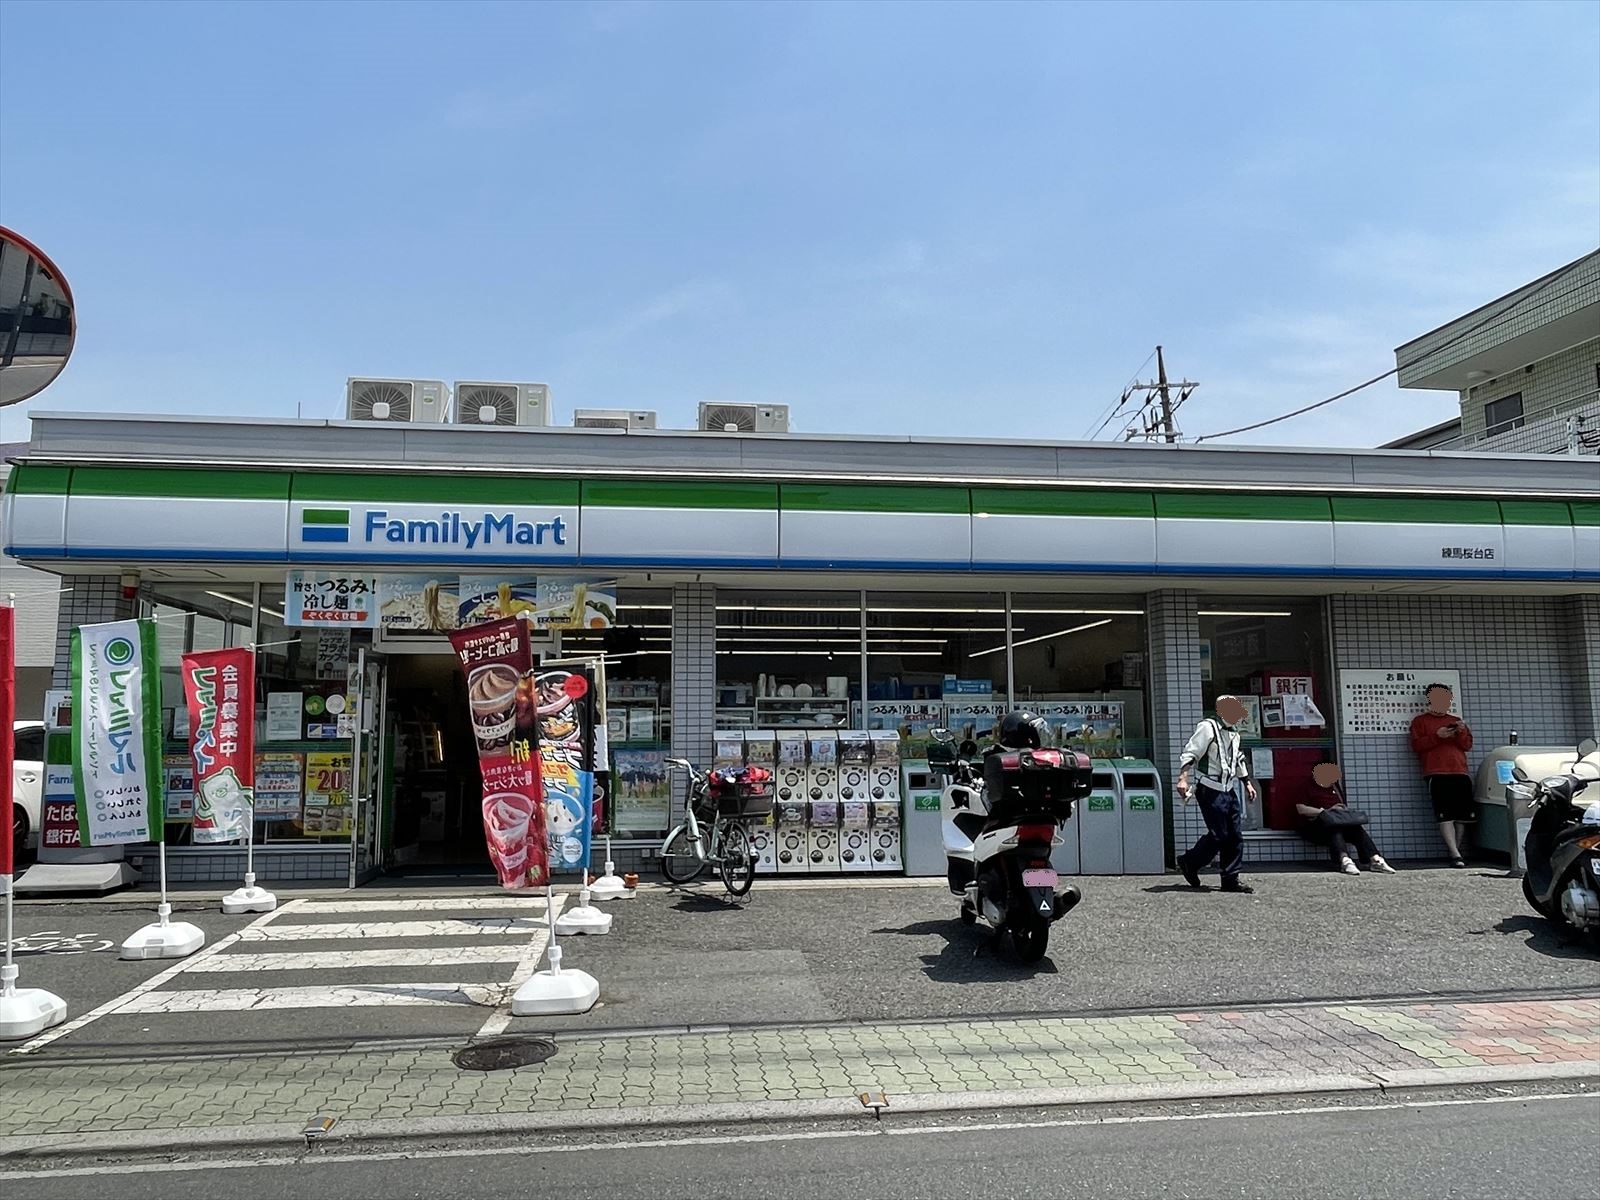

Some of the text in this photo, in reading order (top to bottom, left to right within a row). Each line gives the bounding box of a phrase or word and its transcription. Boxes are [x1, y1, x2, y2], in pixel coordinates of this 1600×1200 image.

[365, 512, 567, 549] FamilyMart
[1441, 547, 1494, 560] 練馬桜台店
[303, 595, 349, 610] 冷し麺
[1386, 673, 1415, 681] お願い
[1276, 678, 1308, 694] 銀行
